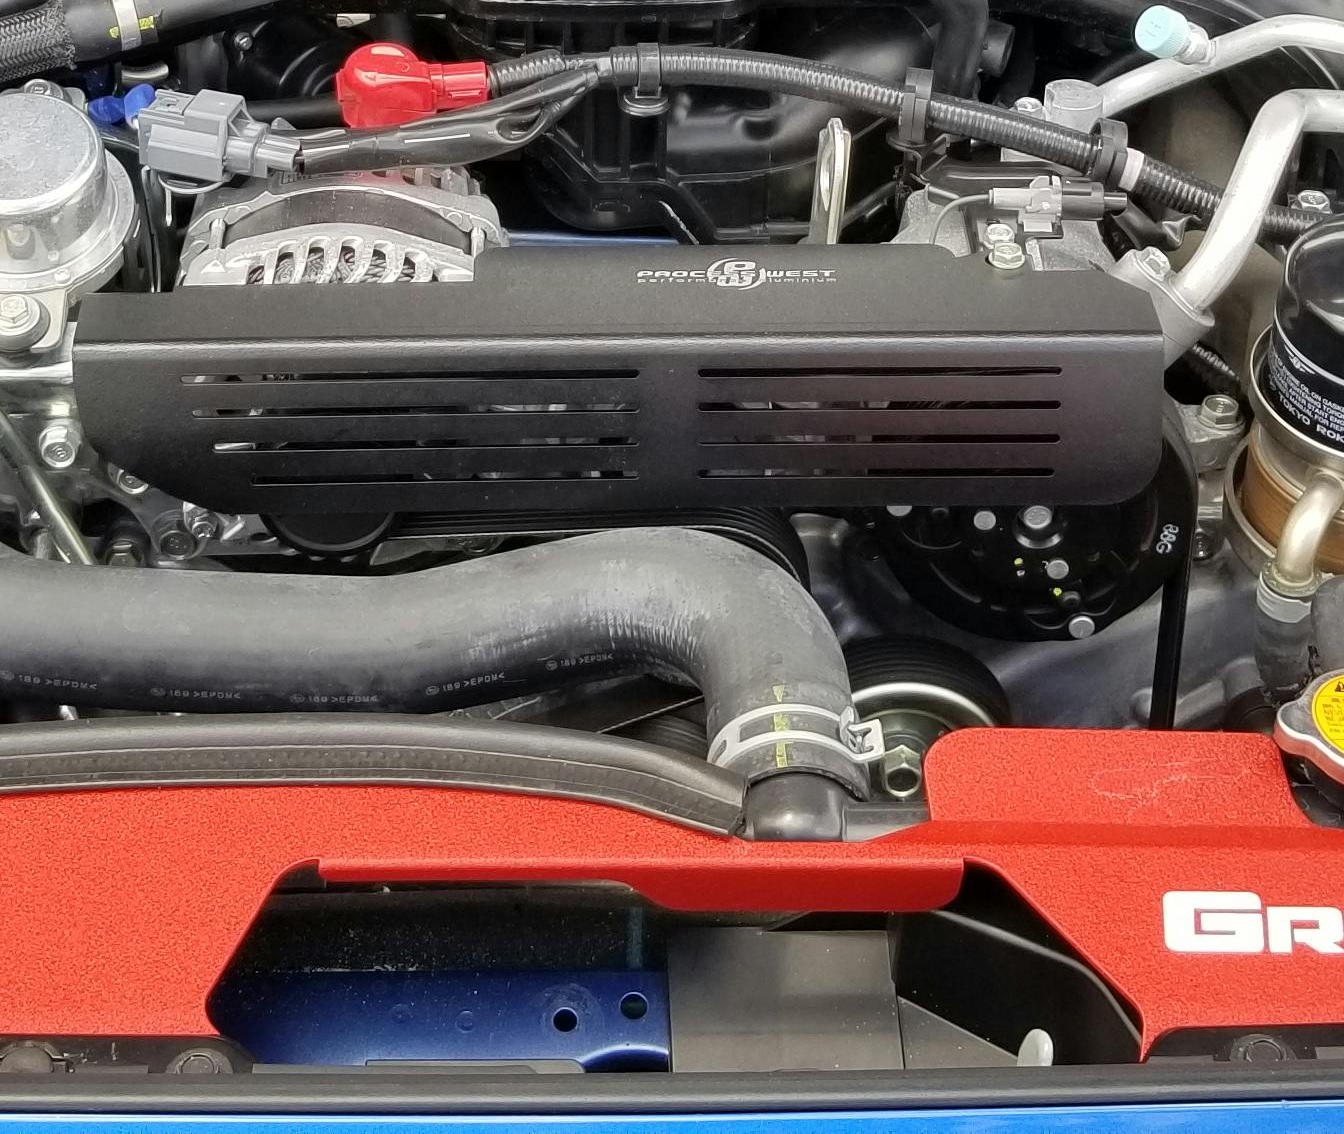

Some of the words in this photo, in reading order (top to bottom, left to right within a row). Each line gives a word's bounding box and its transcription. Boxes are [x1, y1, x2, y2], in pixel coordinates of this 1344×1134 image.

[765, 268, 837, 278] WEST
[1278, 390, 1311, 426] TOKYO
[1314, 414, 1330, 427] FOR
